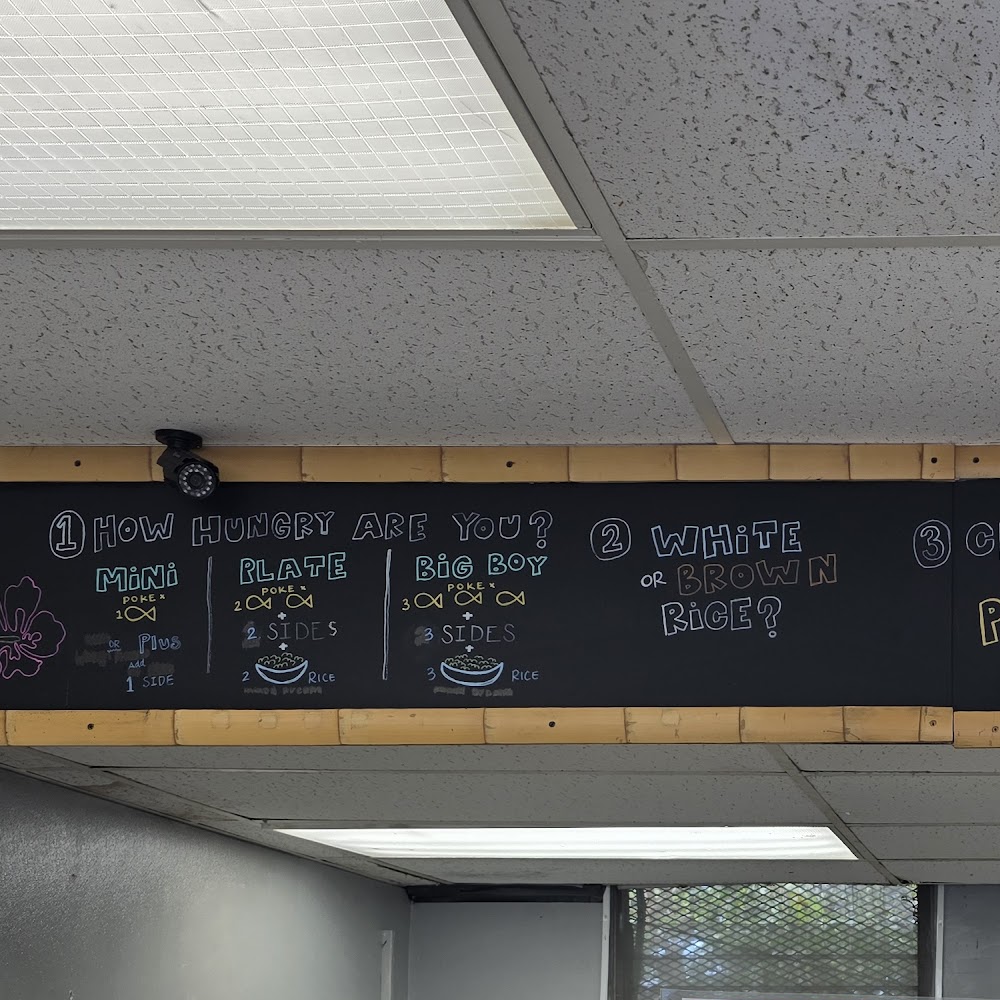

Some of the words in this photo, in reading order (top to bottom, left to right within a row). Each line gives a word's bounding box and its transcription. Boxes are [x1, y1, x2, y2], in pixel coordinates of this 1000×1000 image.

[94, 513, 174, 553] HOW
[192, 511, 335, 546] HUNGRY
[352, 512, 428, 542] ARE
[452, 510, 553, 549] YOU?
[240, 551, 347, 585] PLATE
[488, 553, 547, 576] BOY
[641, 571, 666, 588] OR
[677, 554, 837, 596] BROWN
[262, 585, 295, 595] POKE
[447, 583, 485, 592] POKE
[122, 594, 157, 604] POKE
[441, 623, 516, 643] SIDES
[138, 633, 181, 654] Plus
[143, 674, 174, 688] SIDE
[308, 671, 336, 684] RICE
[511, 670, 539, 683] RICE
